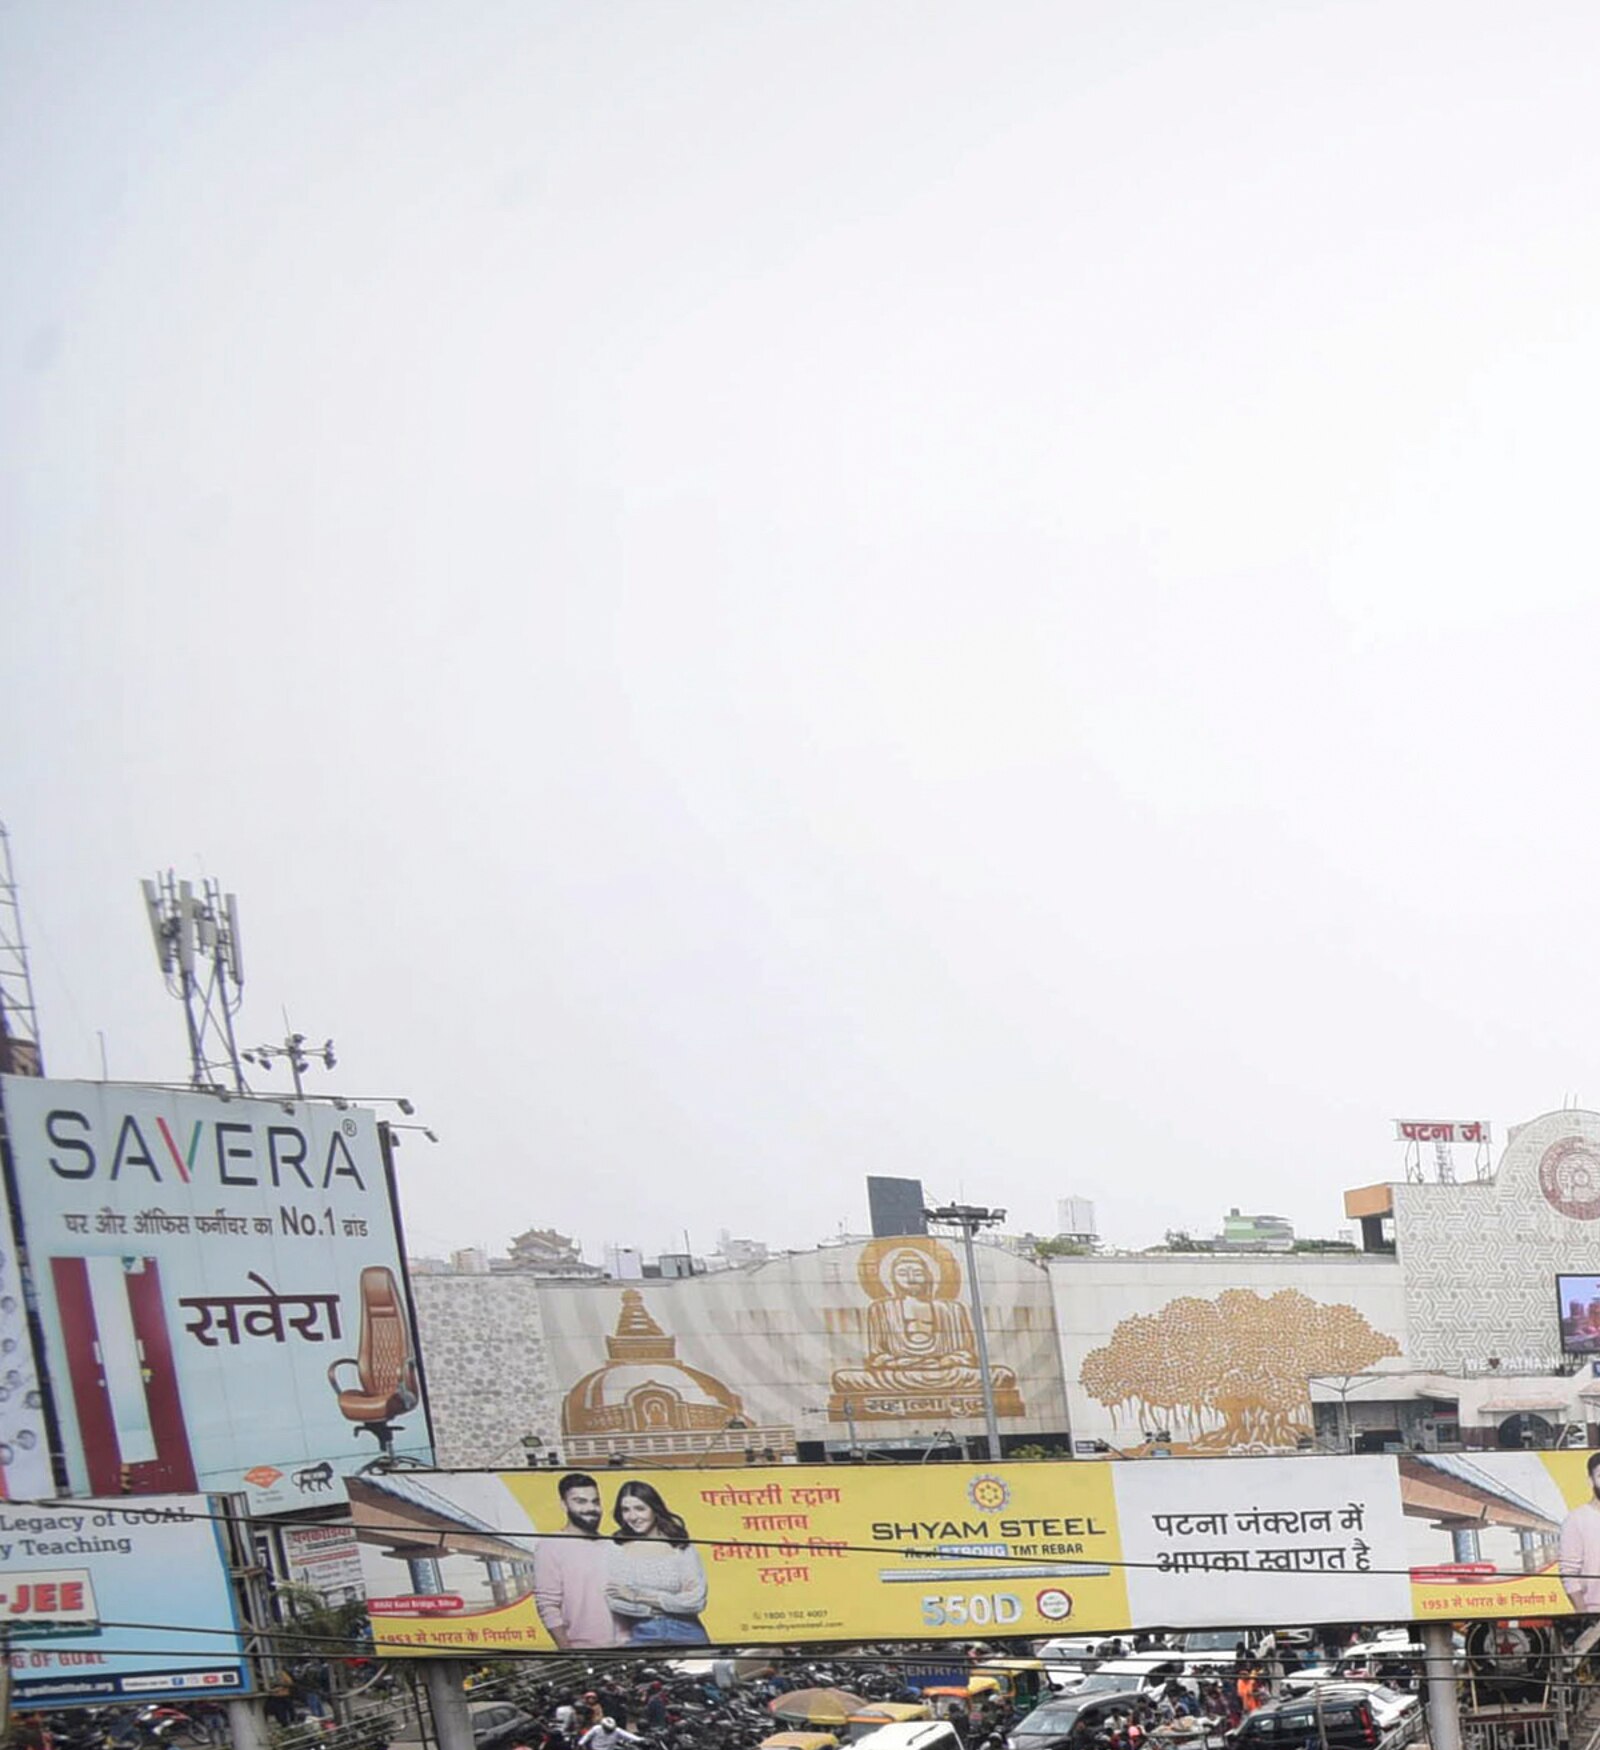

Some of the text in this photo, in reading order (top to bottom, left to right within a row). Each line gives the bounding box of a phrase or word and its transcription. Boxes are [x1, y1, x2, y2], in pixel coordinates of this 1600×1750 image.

[1400, 1122, 1454, 1142] पटना
[45, 1109, 367, 1192] SAVERA
[64, 1213, 87, 1234] घर
[94, 1206, 127, 1234] और
[194, 1207, 249, 1236] फर्नीचर
[253, 1215, 274, 1236] का
[279, 1205, 337, 1237] No.1
[178, 1271, 343, 1347] सवेरा
[1, 1506, 195, 1536] Legacy of GOAL
[741, 1513, 809, 1532] मतलब
[871, 1517, 1107, 1541] SHYAM STEEL
[1151, 1503, 1366, 1537] पटना जंक्शन में
[24, 1535, 133, 1558] Teaching
[777, 1536, 804, 1560] के
[1011, 1544, 1039, 1558] TMT
[1041, 1542, 1084, 1557] REBAR
[1155, 1537, 1371, 1574] आपका स्वागत है
[921, 1591, 1025, 1627] 550D
[1421, 1598, 1449, 1609] 1953
[1465, 1596, 1495, 1609] भारत
[430, 1631, 464, 1645] भारत
